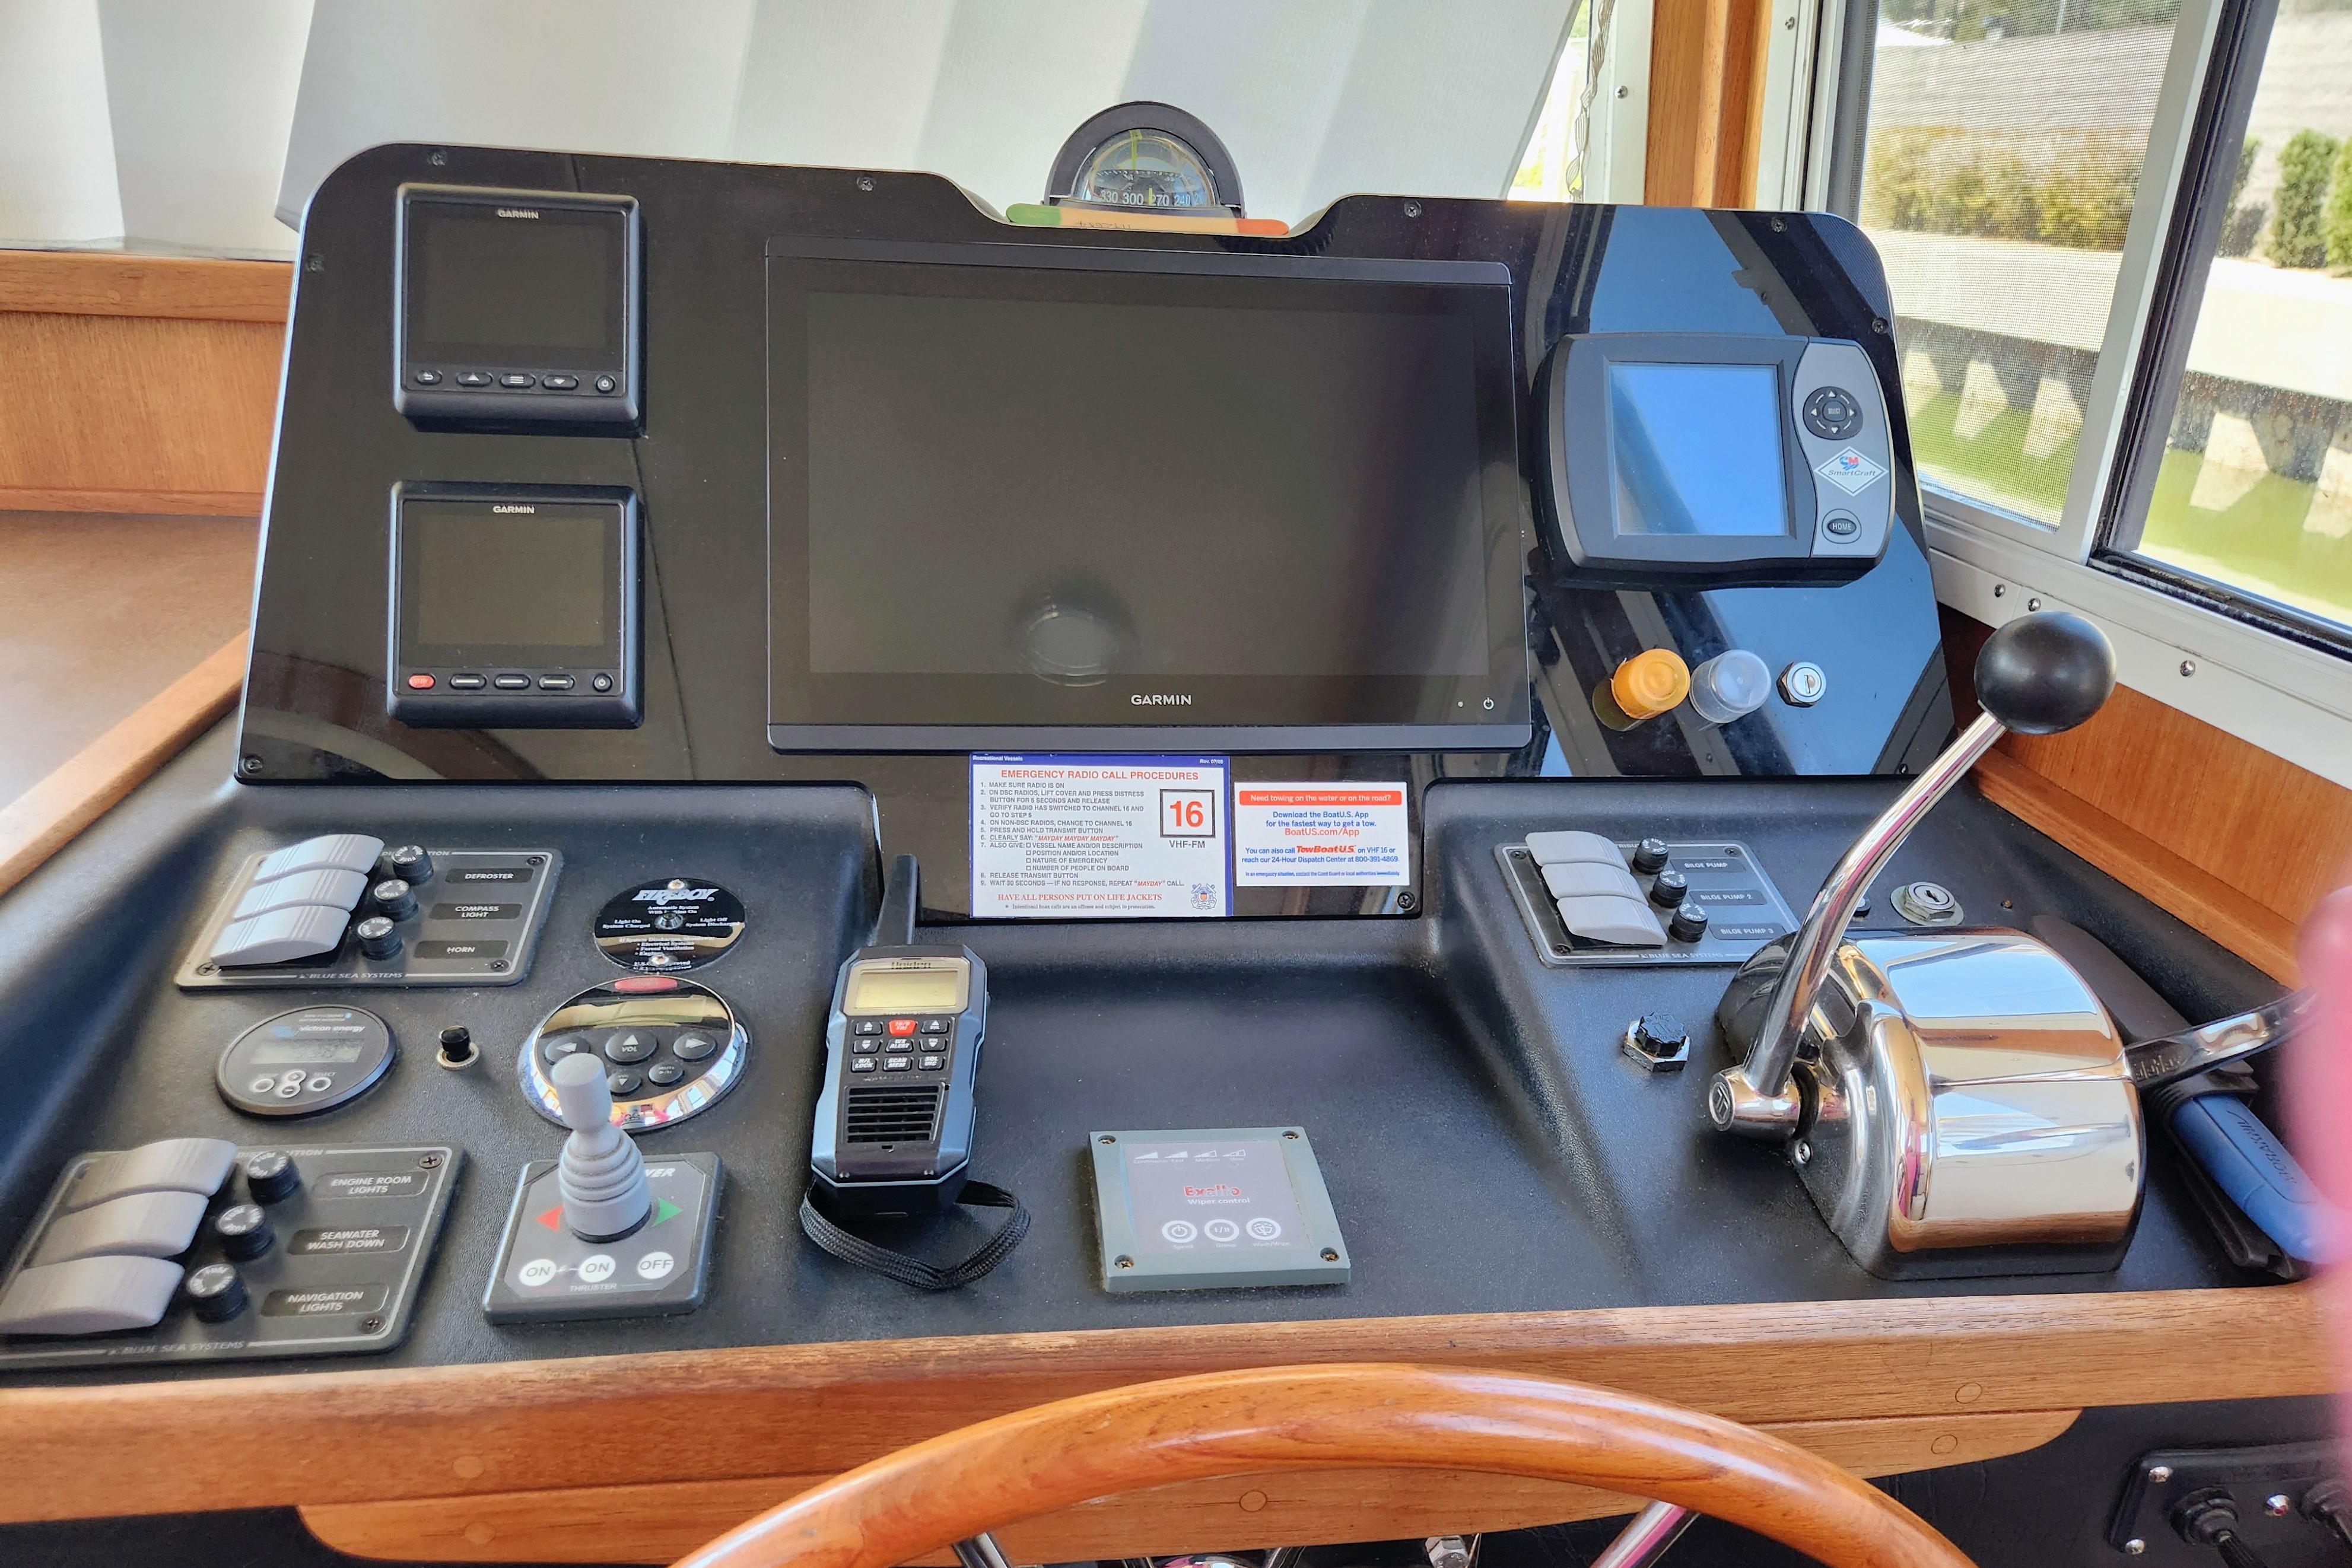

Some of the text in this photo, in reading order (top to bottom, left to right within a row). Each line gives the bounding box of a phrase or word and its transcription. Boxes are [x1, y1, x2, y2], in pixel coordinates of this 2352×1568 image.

[1101, 190, 1190, 206] 330 300 270 240
[498, 208, 539, 219] GARMIN
[1131, 695, 1191, 705] GARMIN
[1068, 771, 1098, 779] RADIO
[1130, 772, 1199, 780] PROCEDURES
[1170, 800, 1204, 827] 16
[1285, 828, 1359, 837] BoatUS.com/App
[1169, 840, 1206, 848] VHF-FM
[632, 889, 719, 905] FIREBOY
[331, 1176, 411, 1187] ENGINE ROOM
[320, 1230, 380, 1240] SEAWATER
[307, 1239, 385, 1250] WASH DOWN
[526, 1260, 672, 1277] ON ON OFF
[570, 1283, 617, 1292] THRUSTER
[286, 1292, 364, 1303] NAVIGATION
[300, 1303, 343, 1312] LIGHTS
[160, 1344, 186, 1352] SEA
[189, 1341, 245, 1351] SYSTEMS
